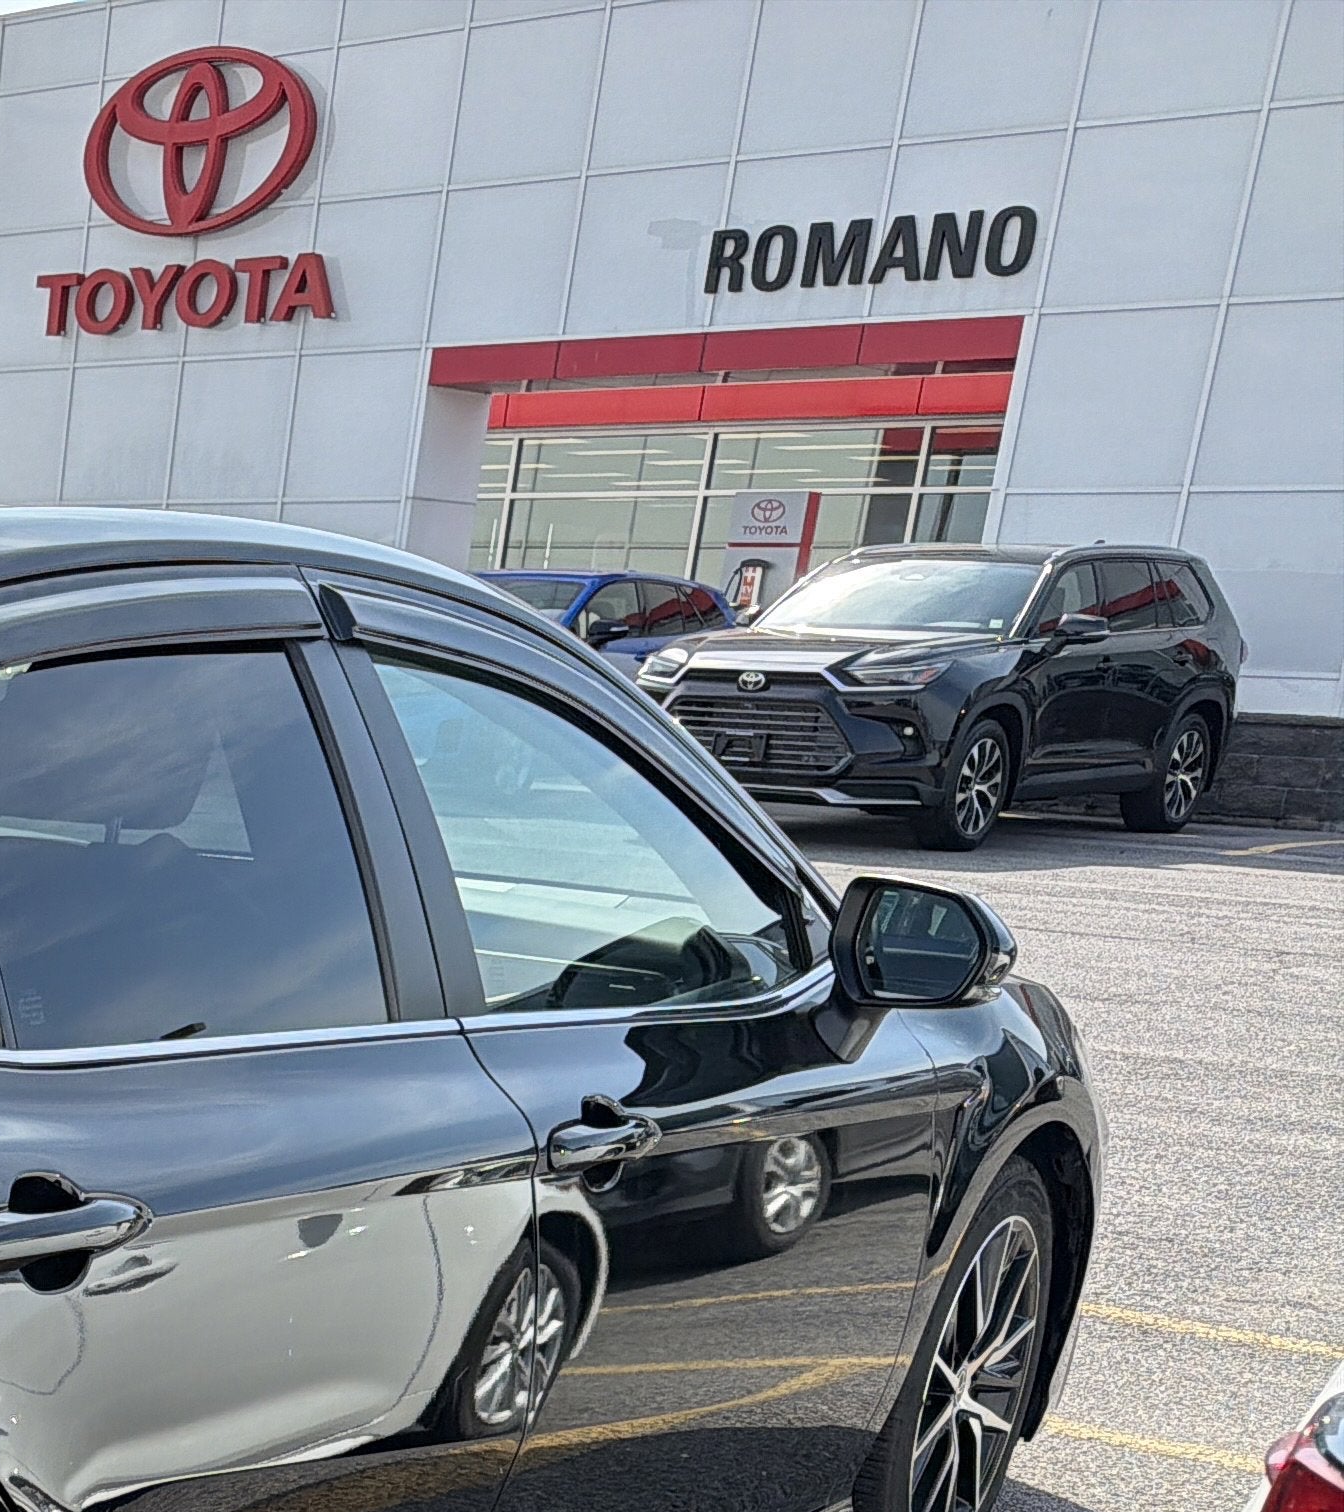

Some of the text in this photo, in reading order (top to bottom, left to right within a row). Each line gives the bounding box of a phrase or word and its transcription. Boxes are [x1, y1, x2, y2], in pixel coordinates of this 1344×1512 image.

[704, 205, 1038, 294] ROMANO
[36, 252, 336, 336] TOYOTA
[742, 525, 788, 536] TOYOTA
